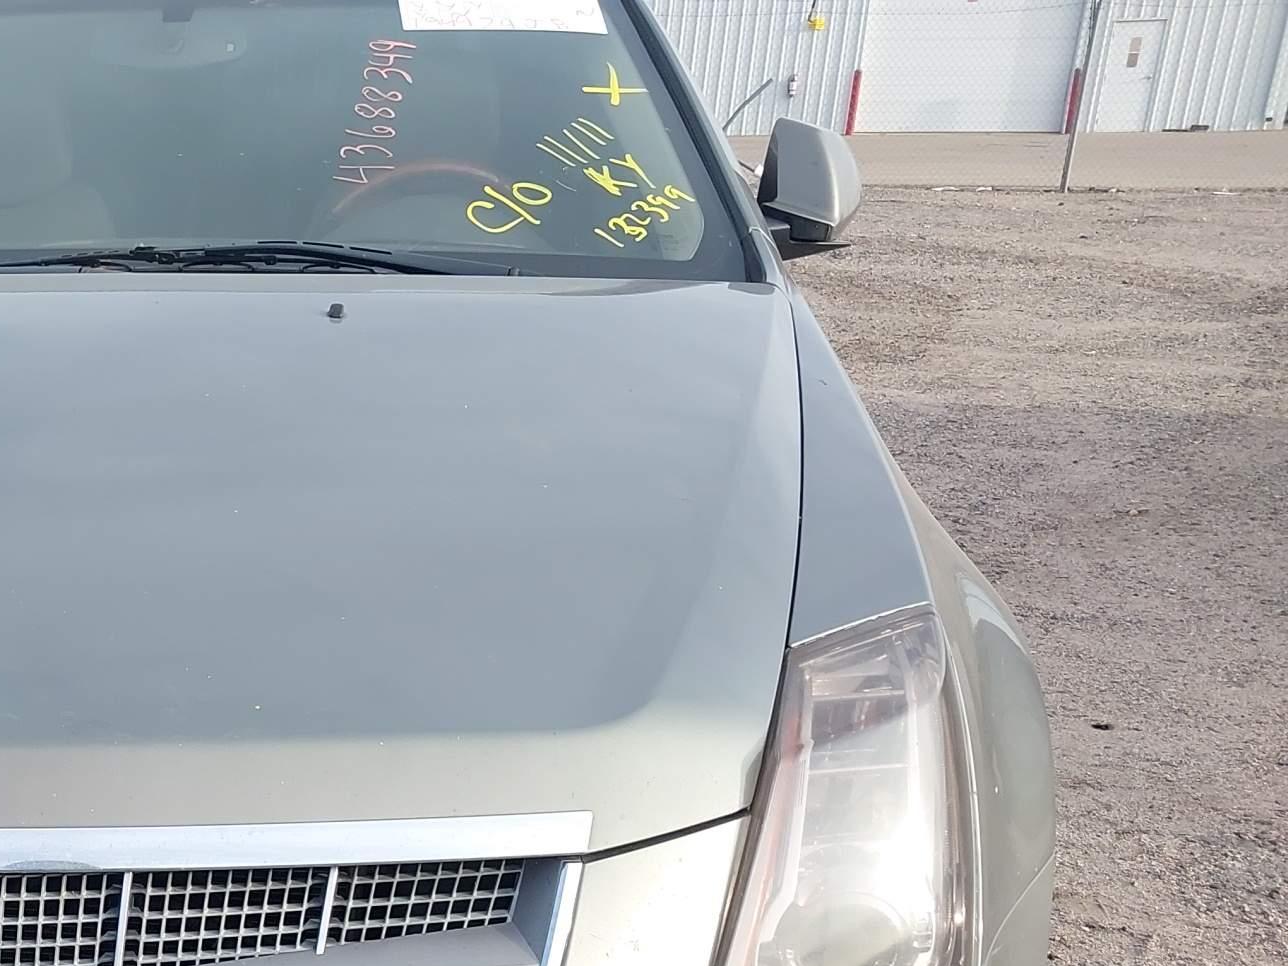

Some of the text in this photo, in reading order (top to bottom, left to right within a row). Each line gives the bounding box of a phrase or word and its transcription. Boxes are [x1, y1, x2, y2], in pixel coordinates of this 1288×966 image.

[331, 38, 417, 185] 43688349
[583, 153, 657, 197] KY
[466, 181, 553, 234] C/O
